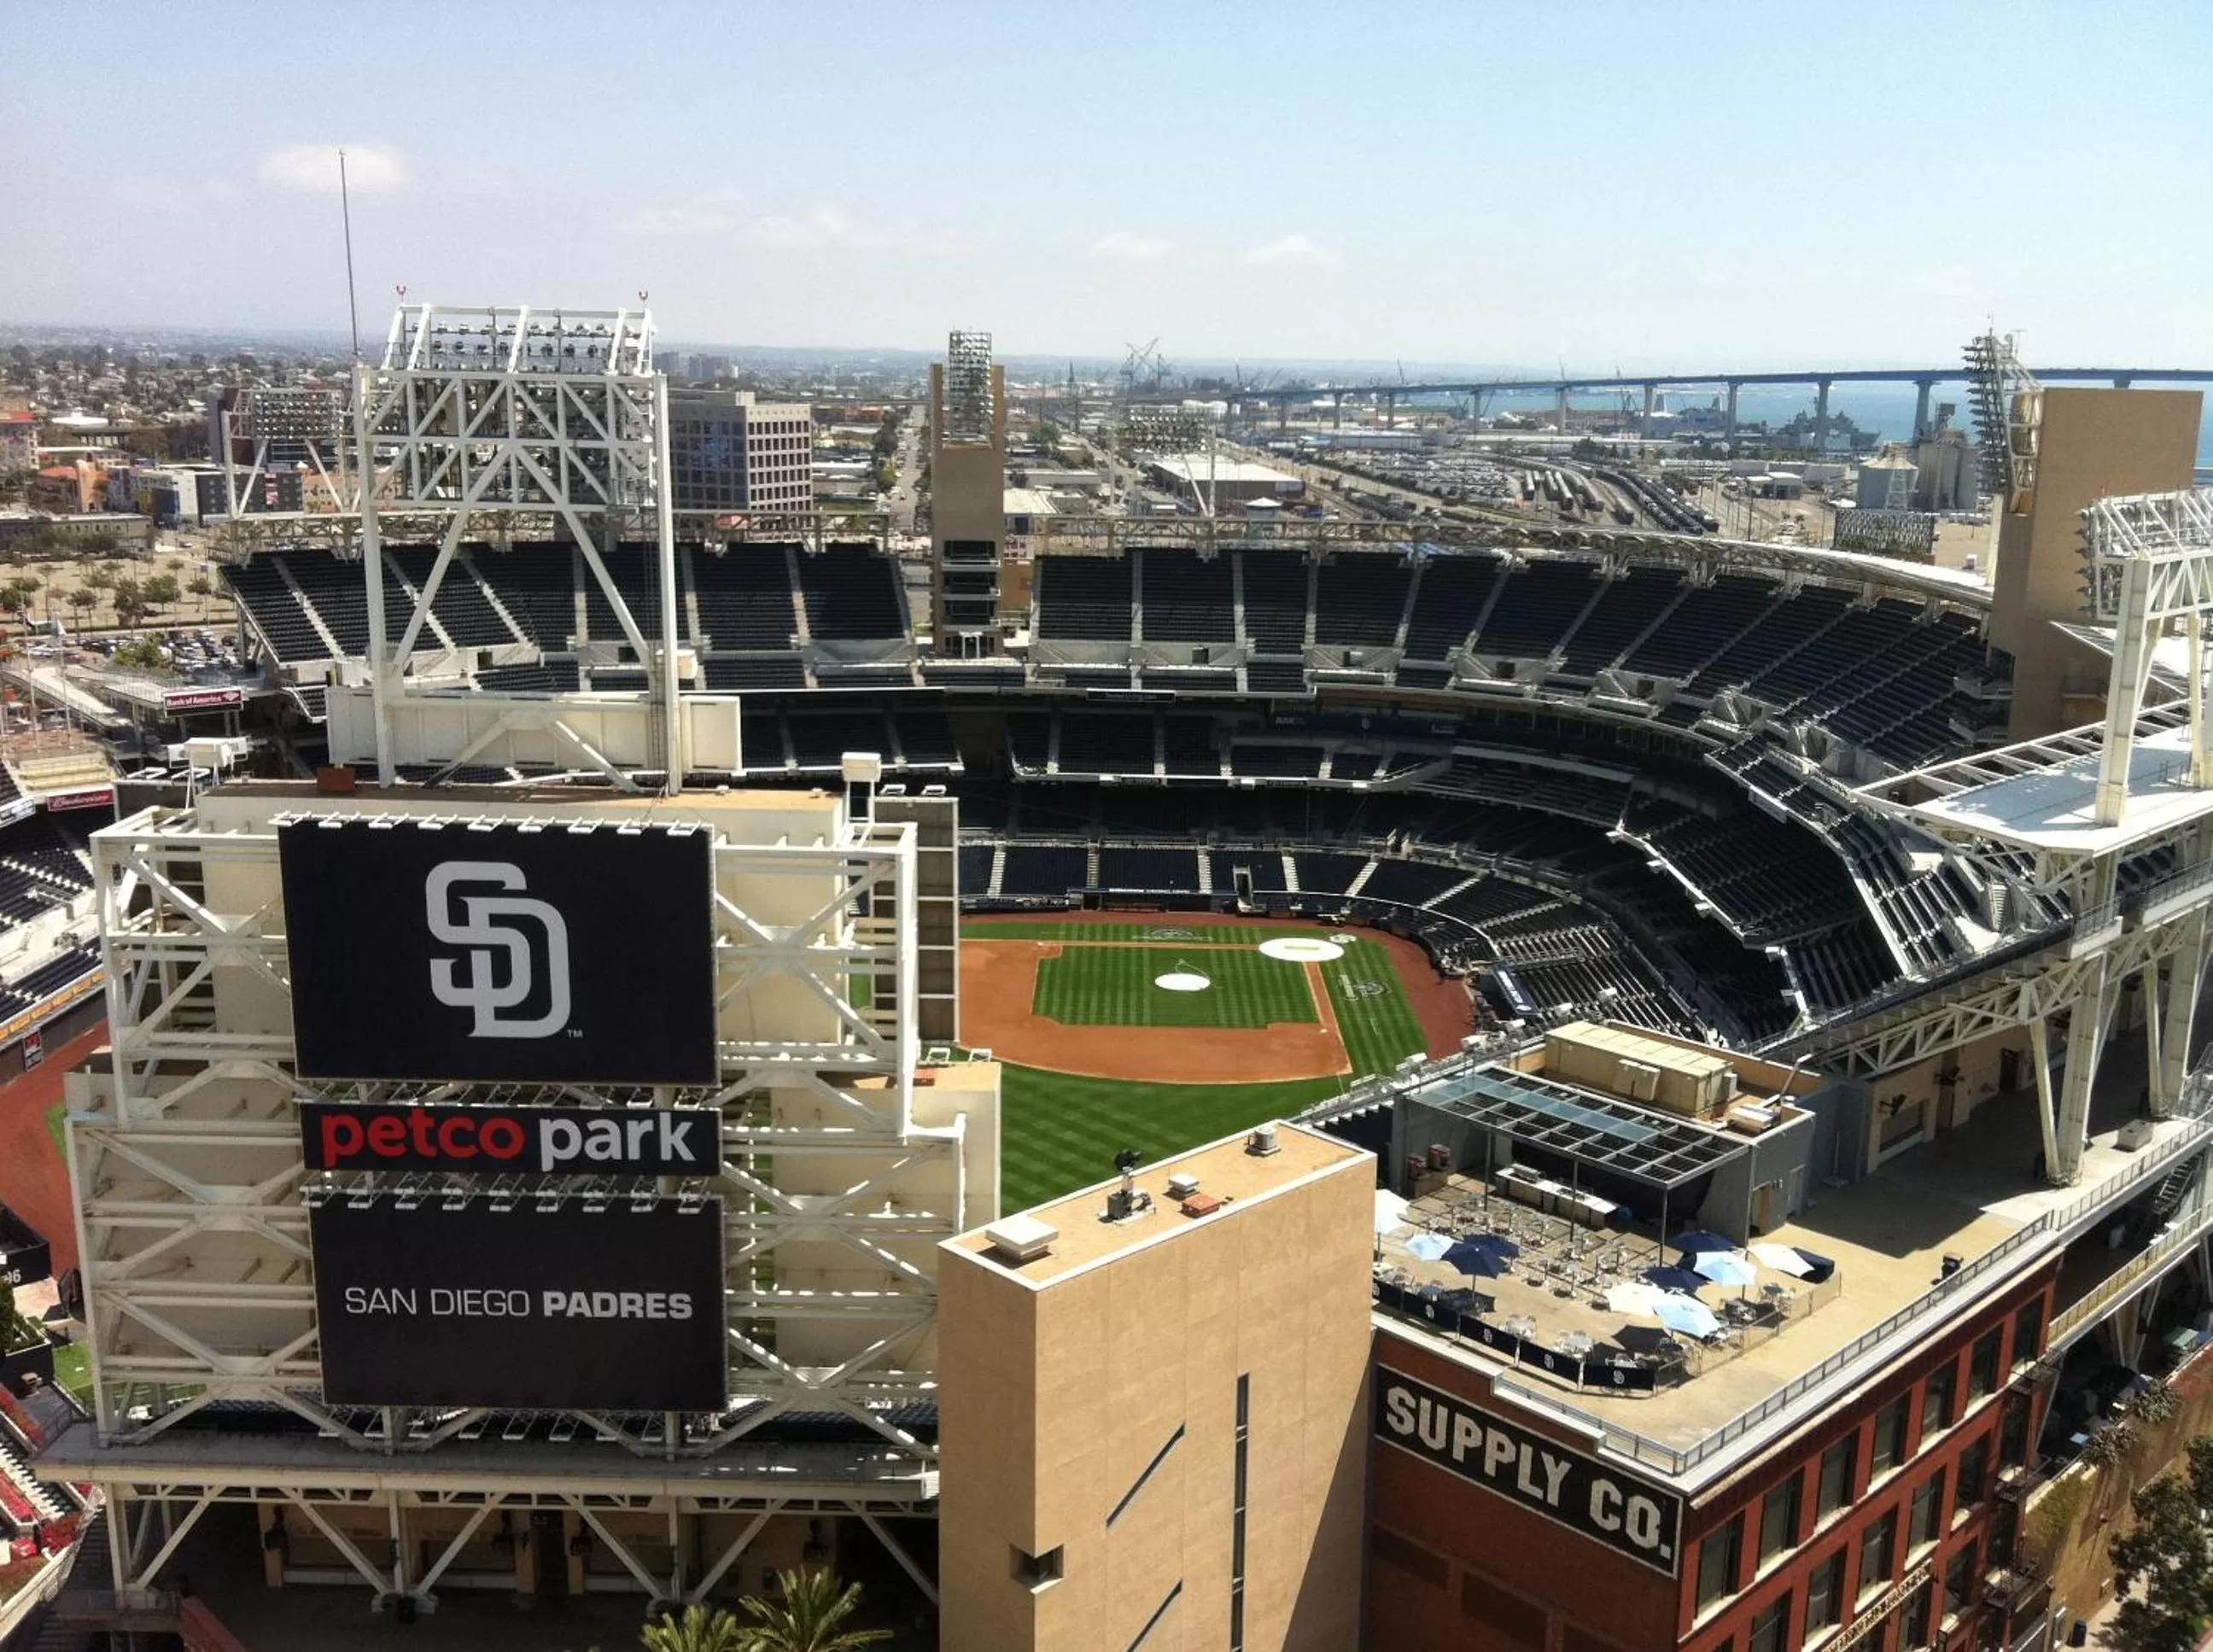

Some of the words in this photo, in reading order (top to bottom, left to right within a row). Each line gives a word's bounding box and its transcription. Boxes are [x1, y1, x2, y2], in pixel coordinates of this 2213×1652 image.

[321, 1108, 526, 1168] petco
[538, 1111, 697, 1172] park
[344, 1287, 417, 1316] SAN
[429, 1288, 531, 1317] DIEGO
[542, 1290, 694, 1320] PADRES
[1385, 1385, 1573, 1508] SUPPLY
[1589, 1478, 1673, 1560] CO.
